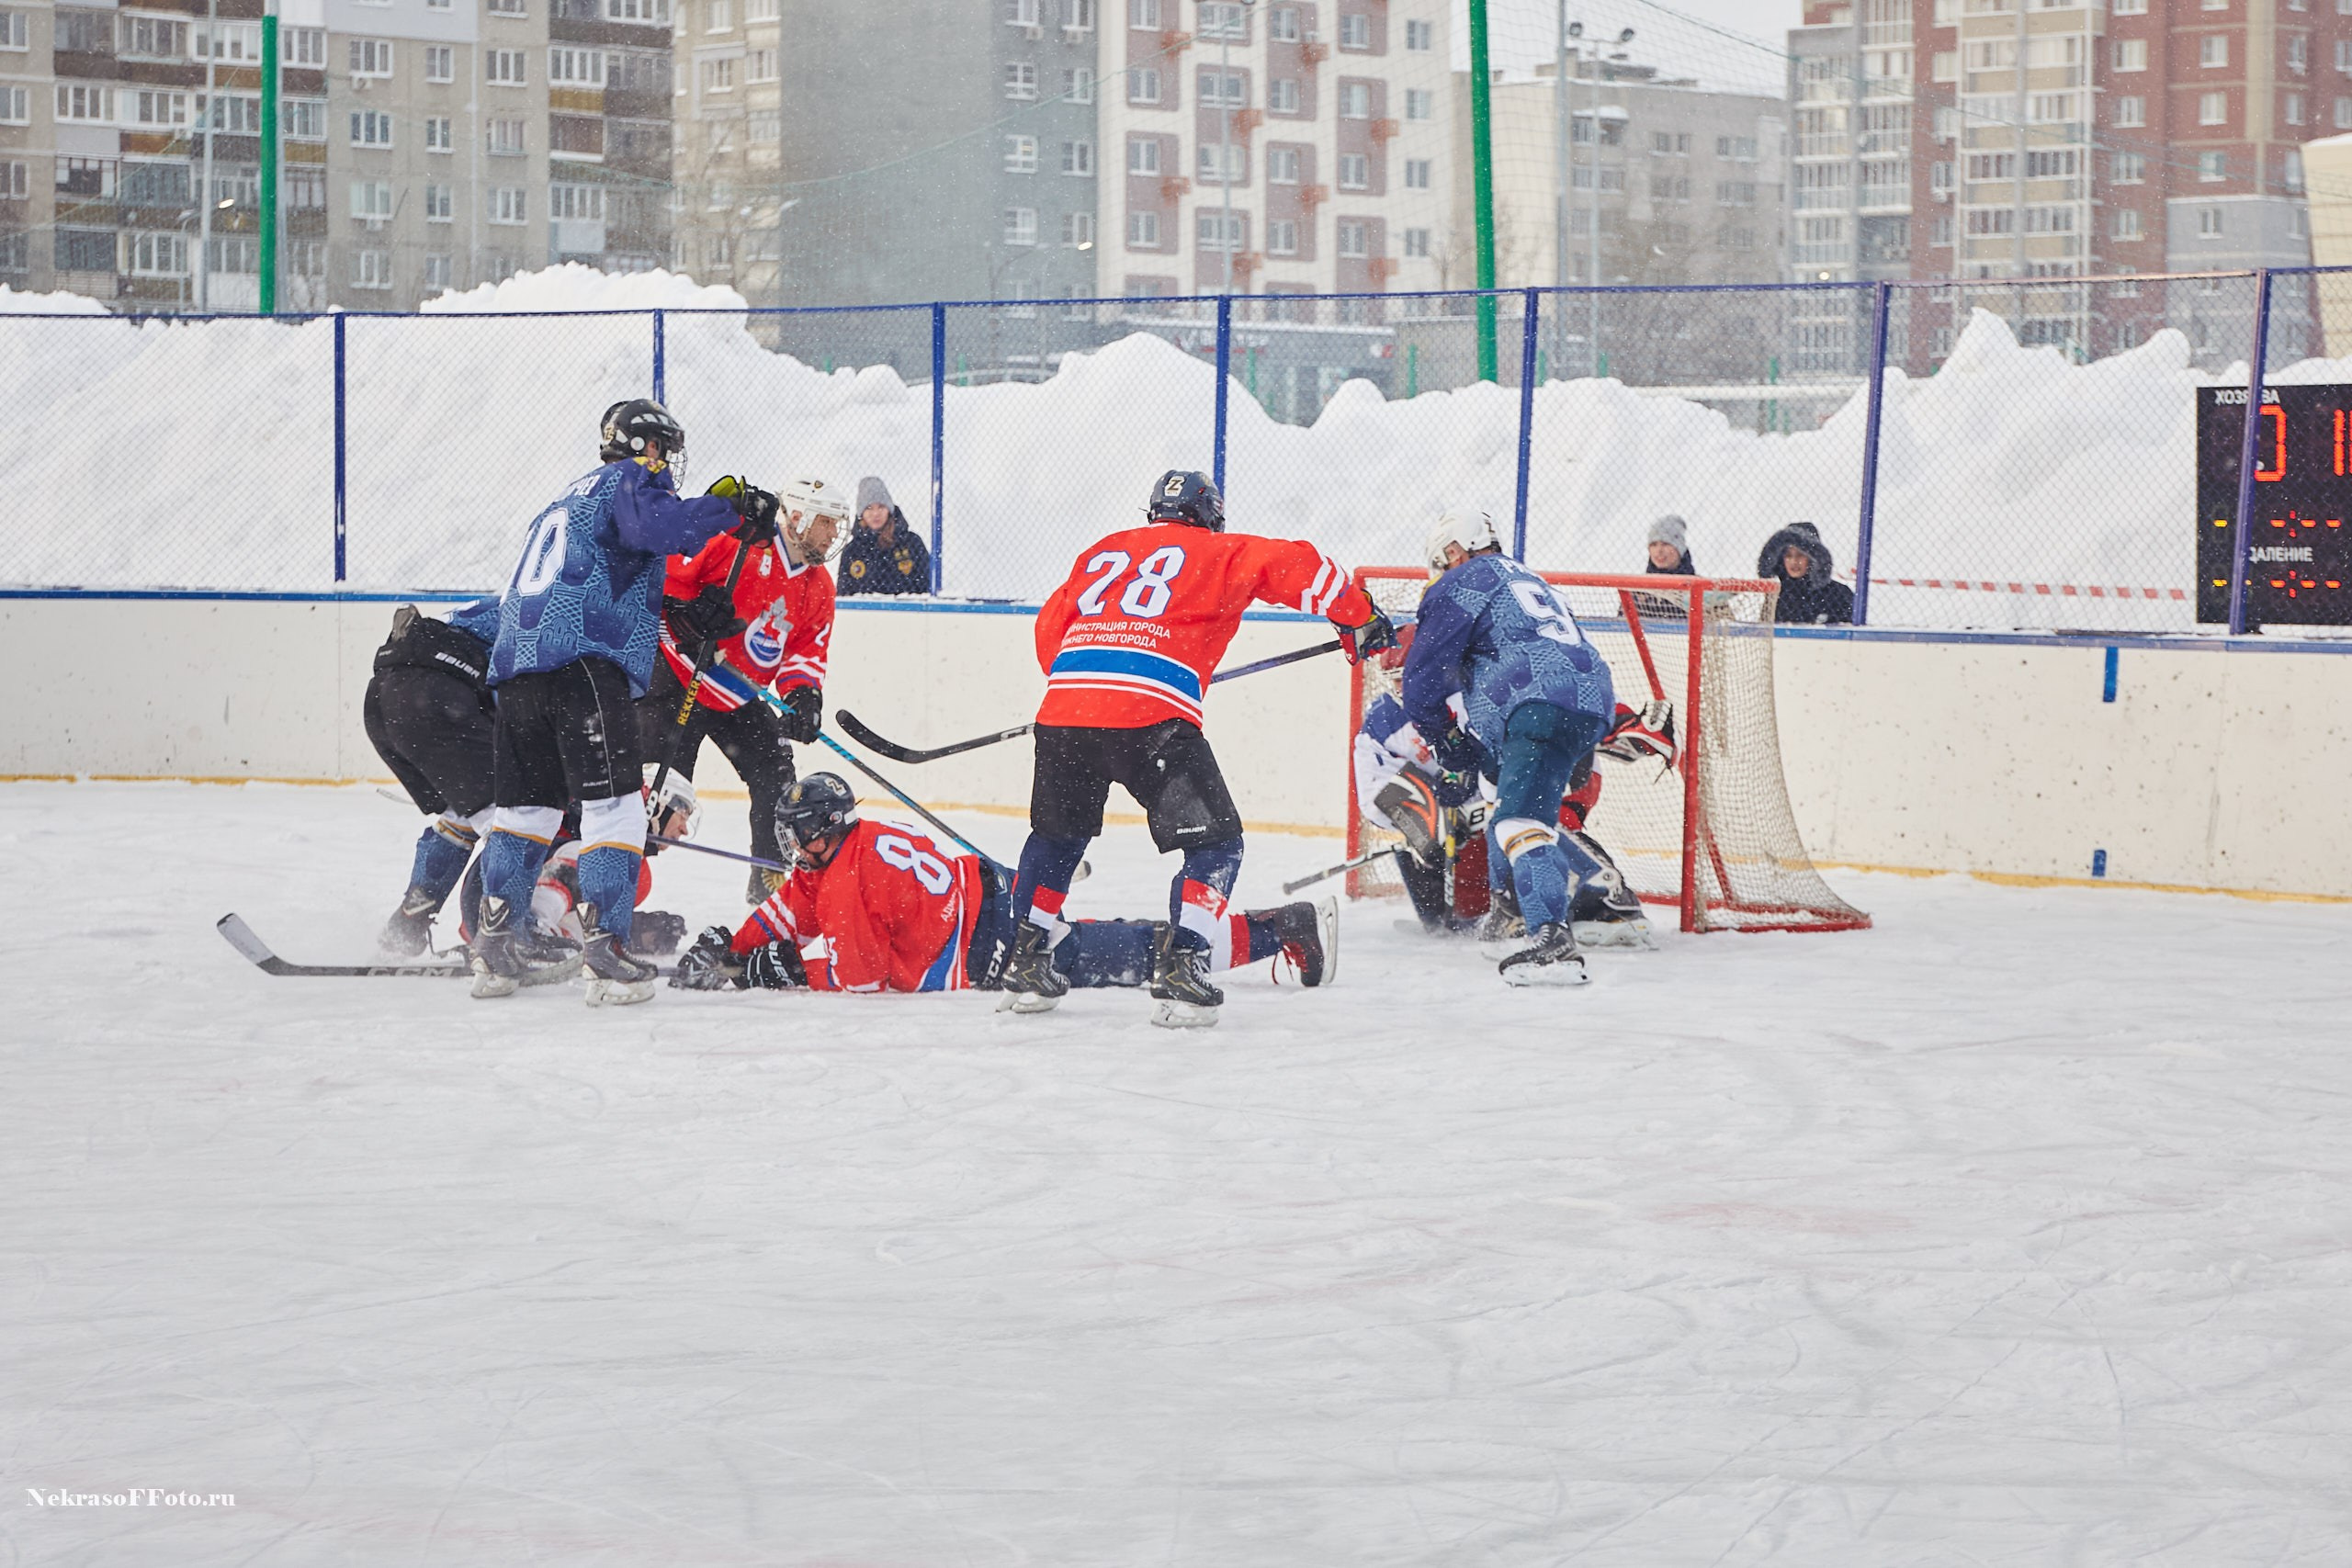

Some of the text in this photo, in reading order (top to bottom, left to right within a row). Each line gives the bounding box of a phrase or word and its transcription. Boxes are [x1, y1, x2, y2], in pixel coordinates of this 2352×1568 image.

[2214, 389, 2280, 405] ХОЗЯВА
[2249, 546, 2313, 563] ДАЛЕНИЕ
[1077, 546, 1186, 618] 28
[1128, 621, 1171, 638] ГОРОДА
[1094, 633, 1158, 649] НОВГОРОДА
[677, 680, 701, 727] REKKER
[768, 940, 796, 987] AUER
